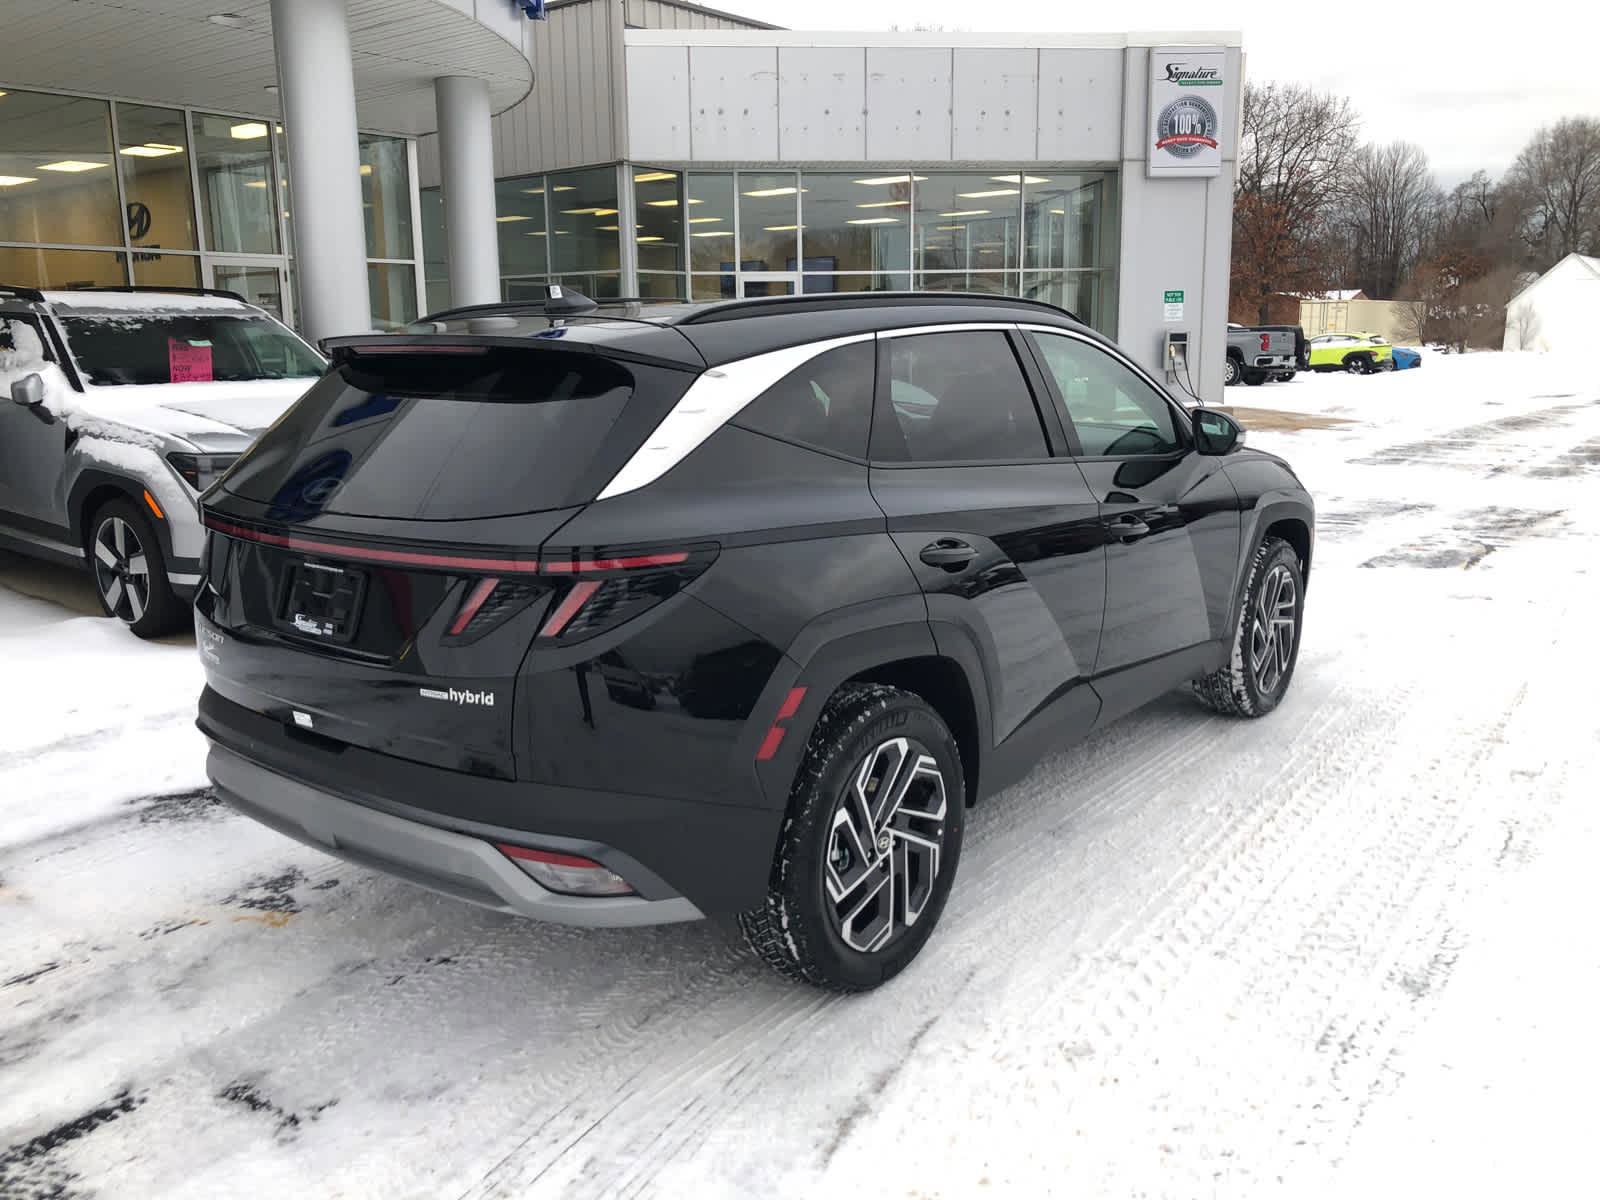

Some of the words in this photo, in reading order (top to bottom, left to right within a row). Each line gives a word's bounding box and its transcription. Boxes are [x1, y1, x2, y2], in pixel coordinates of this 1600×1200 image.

[1160, 62, 1217, 83] Signature
[1174, 114, 1202, 134] 100%
[449, 687, 494, 706] hybrid
